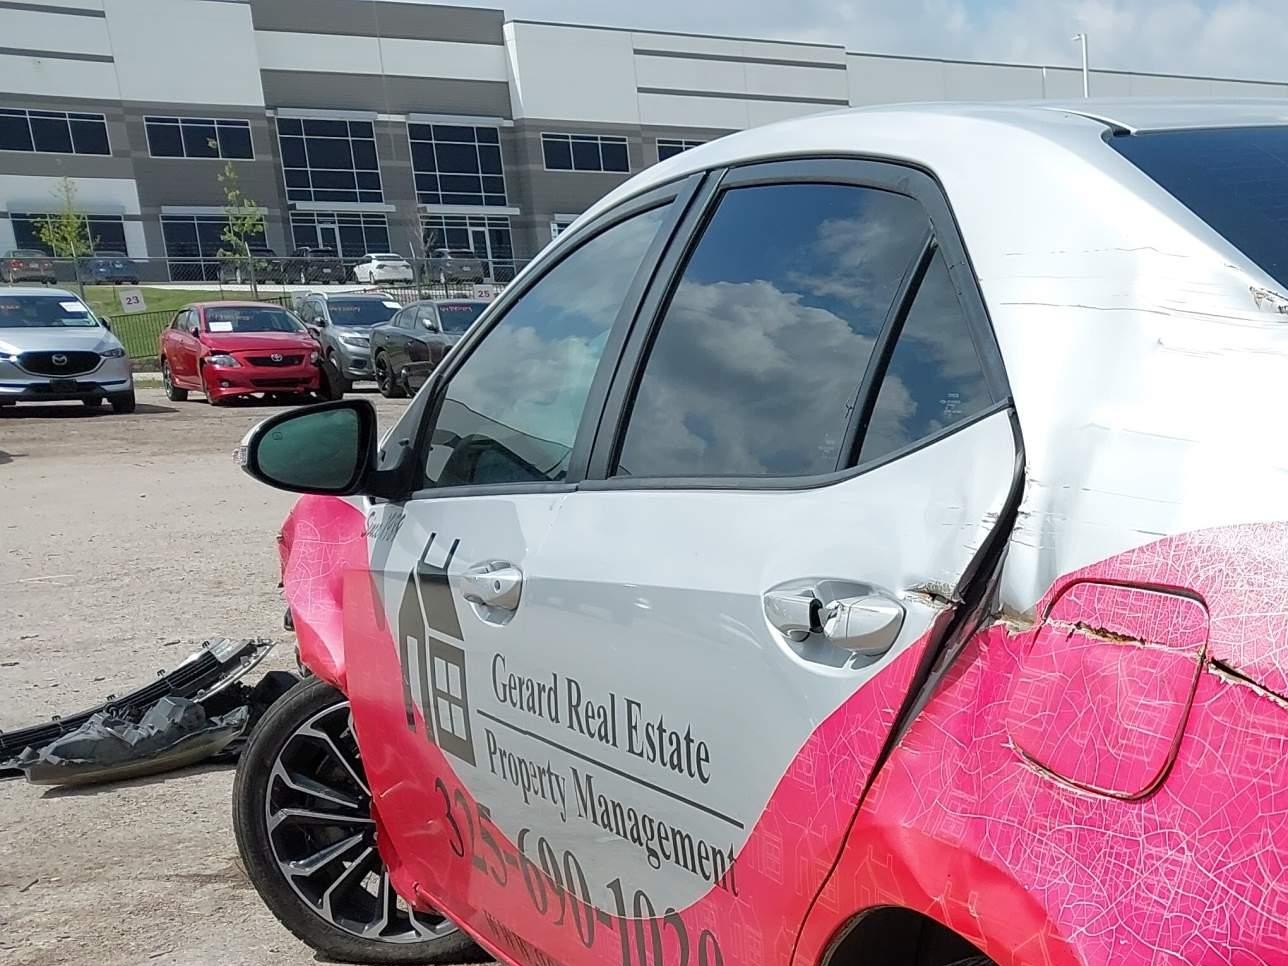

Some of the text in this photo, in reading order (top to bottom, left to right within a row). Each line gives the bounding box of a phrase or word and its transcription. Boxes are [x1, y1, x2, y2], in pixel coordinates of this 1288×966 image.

[126, 295, 140, 305] 23
[478, 290, 490, 298] 25
[491, 652, 712, 784] Gerard Real Estate
[484, 727, 739, 898] Property Management
